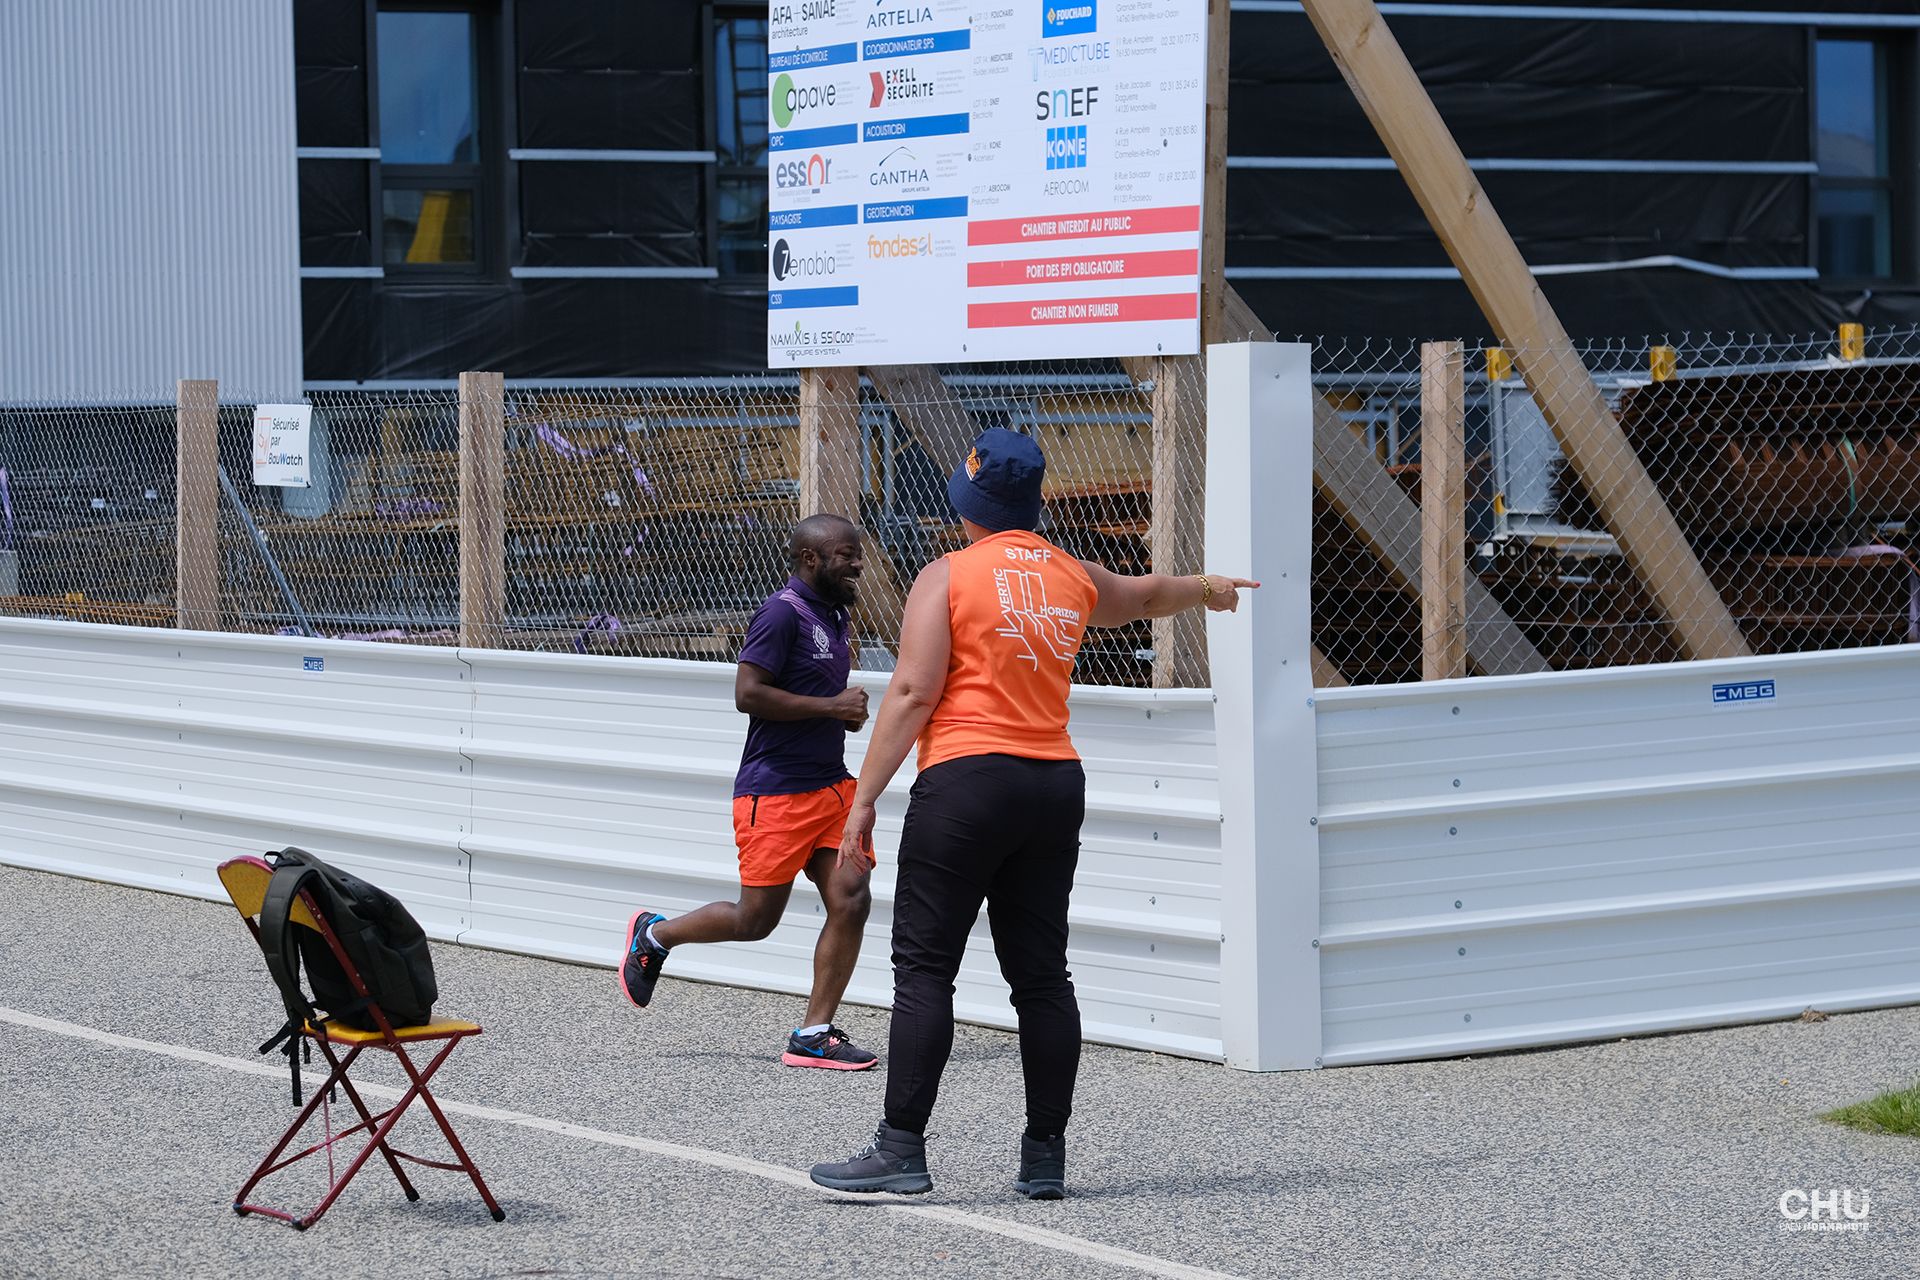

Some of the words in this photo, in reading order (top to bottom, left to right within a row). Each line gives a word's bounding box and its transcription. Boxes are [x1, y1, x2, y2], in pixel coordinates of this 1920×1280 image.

[772, 7, 793, 26] AFA
[801, 0, 836, 22] SANAE
[866, 7, 933, 29] ARTELIA
[1055, 6, 1092, 20] FOUCHARD
[772, 26, 809, 40] architecture
[866, 38, 922, 56] COORDONNATEUR
[923, 37, 935, 50] SPS
[886, 68, 916, 85] EXELL
[786, 84, 836, 114] apave
[887, 82, 934, 100] SECURITE
[867, 123, 906, 138] ACOUSTICIEN
[771, 135, 784, 147] OPC
[1047, 138, 1086, 158] KONE
[870, 169, 929, 185] GANTHA
[1044, 179, 1089, 196] AEROCOM
[771, 213, 802, 225] PAYSAGISTE
[867, 205, 915, 219] GEOTECHNICIEN
[1021, 221, 1057, 237] CHANTIER
[1058, 219, 1090, 235] INTERDIT
[1090, 219, 1101, 232] AU
[1104, 216, 1131, 231] PUBLIC
[868, 232, 933, 259] fondasol
[1026, 264, 1044, 278] PORT
[1046, 263, 1060, 277] DES
[1061, 262, 1072, 276] EPI
[1073, 260, 1124, 276] OBLIGATOIRE
[1031, 304, 1067, 320] CHANTIER
[1068, 304, 1087, 318] NON
[1088, 303, 1119, 317] FUMEUR
[786, 349, 813, 358] GROUPE
[815, 348, 841, 356] SYSTEA
[272, 417, 300, 431] Sécurisé
[270, 436, 281, 449] par
[268, 453, 303, 466] BauWatch
[1004, 547, 1052, 563] STAFF
[993, 568, 1011, 615] VERTIC
[1040, 605, 1080, 621] HORIZON
